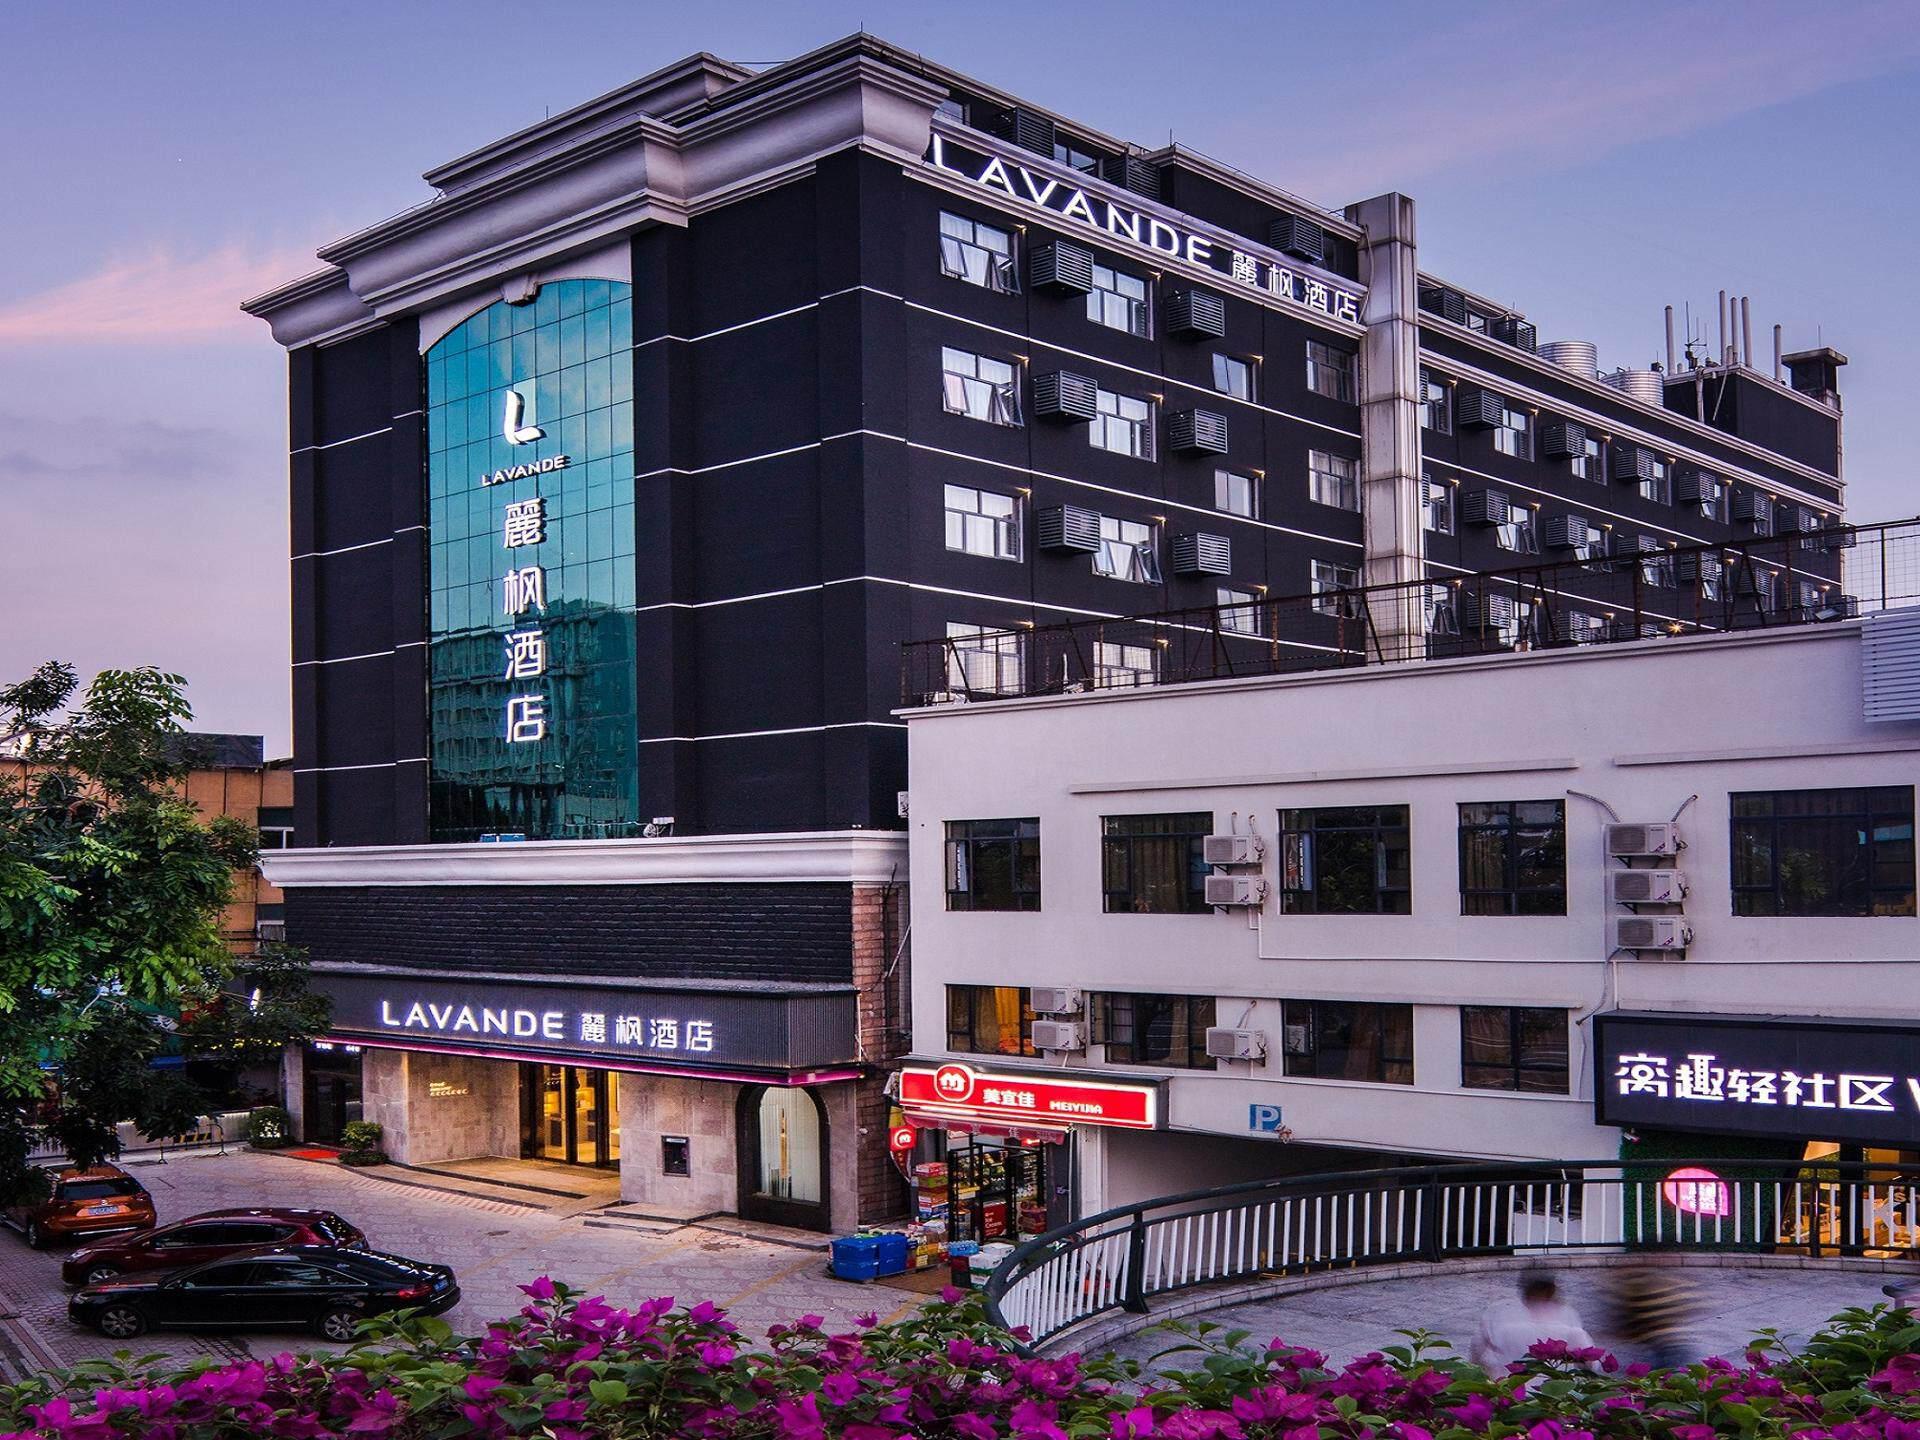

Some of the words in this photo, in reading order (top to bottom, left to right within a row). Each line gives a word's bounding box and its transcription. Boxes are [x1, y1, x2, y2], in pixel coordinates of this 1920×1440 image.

[933, 133, 1213, 269] LAVANDE
[481, 455, 566, 487] LAVANDE
[382, 1000, 564, 1040] LAVANDE
[983, 1088, 1036, 1108] 美宜佳
[1255, 1105, 1279, 1131] P
